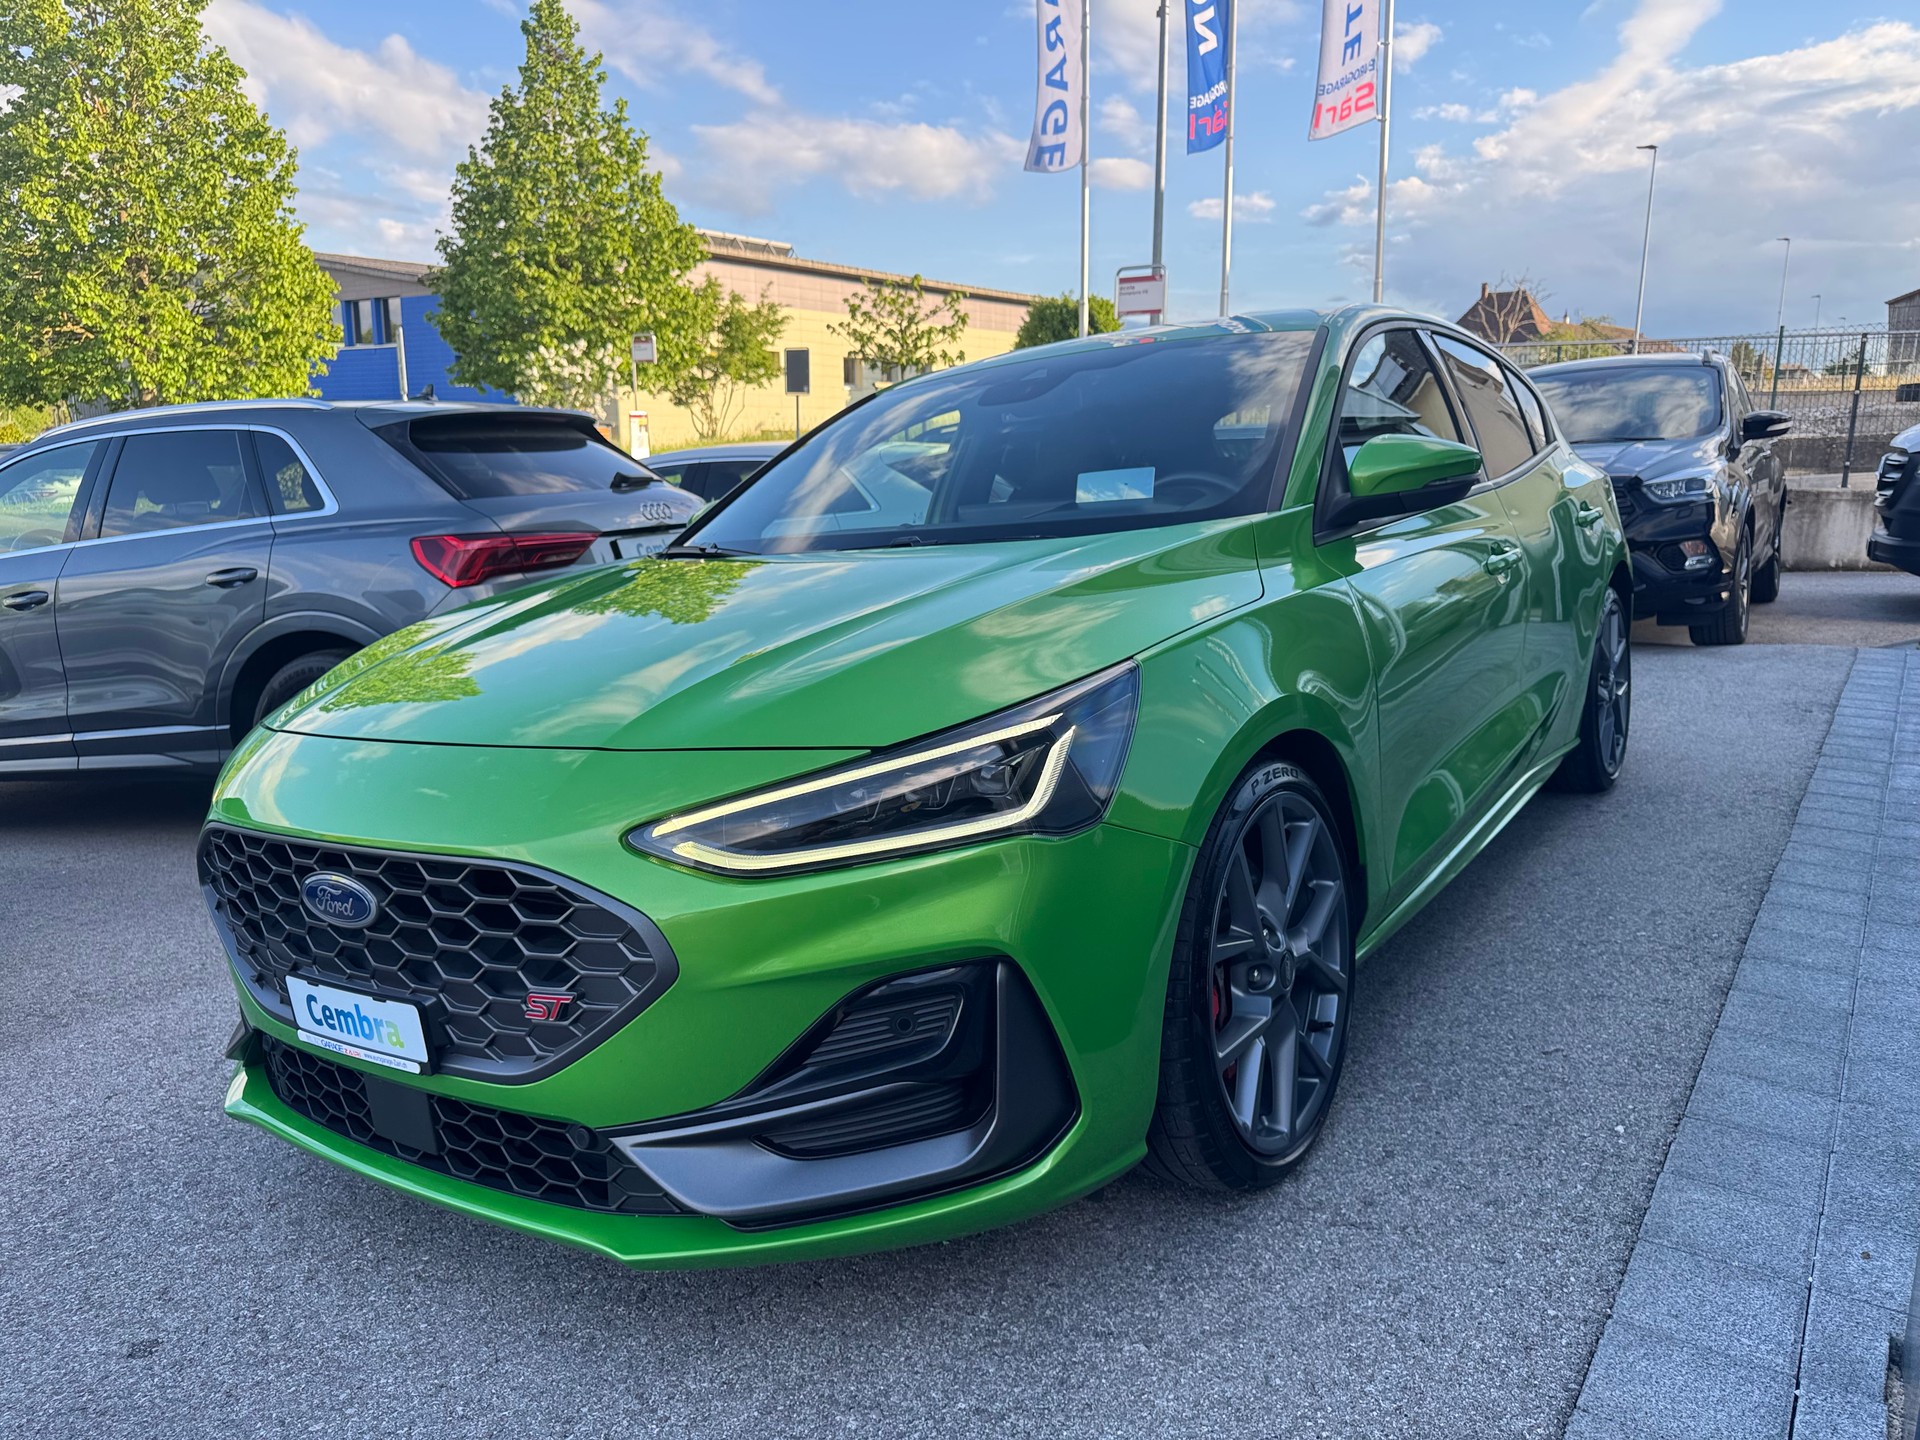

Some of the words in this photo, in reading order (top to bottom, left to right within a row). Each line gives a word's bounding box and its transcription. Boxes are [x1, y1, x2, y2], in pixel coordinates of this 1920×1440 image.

[1251, 778, 1260, 797] P
[1262, 766, 1299, 785] ZERO
[316, 885, 355, 916] Ford
[305, 993, 406, 1049] Cembra
[525, 993, 574, 1021] ST
